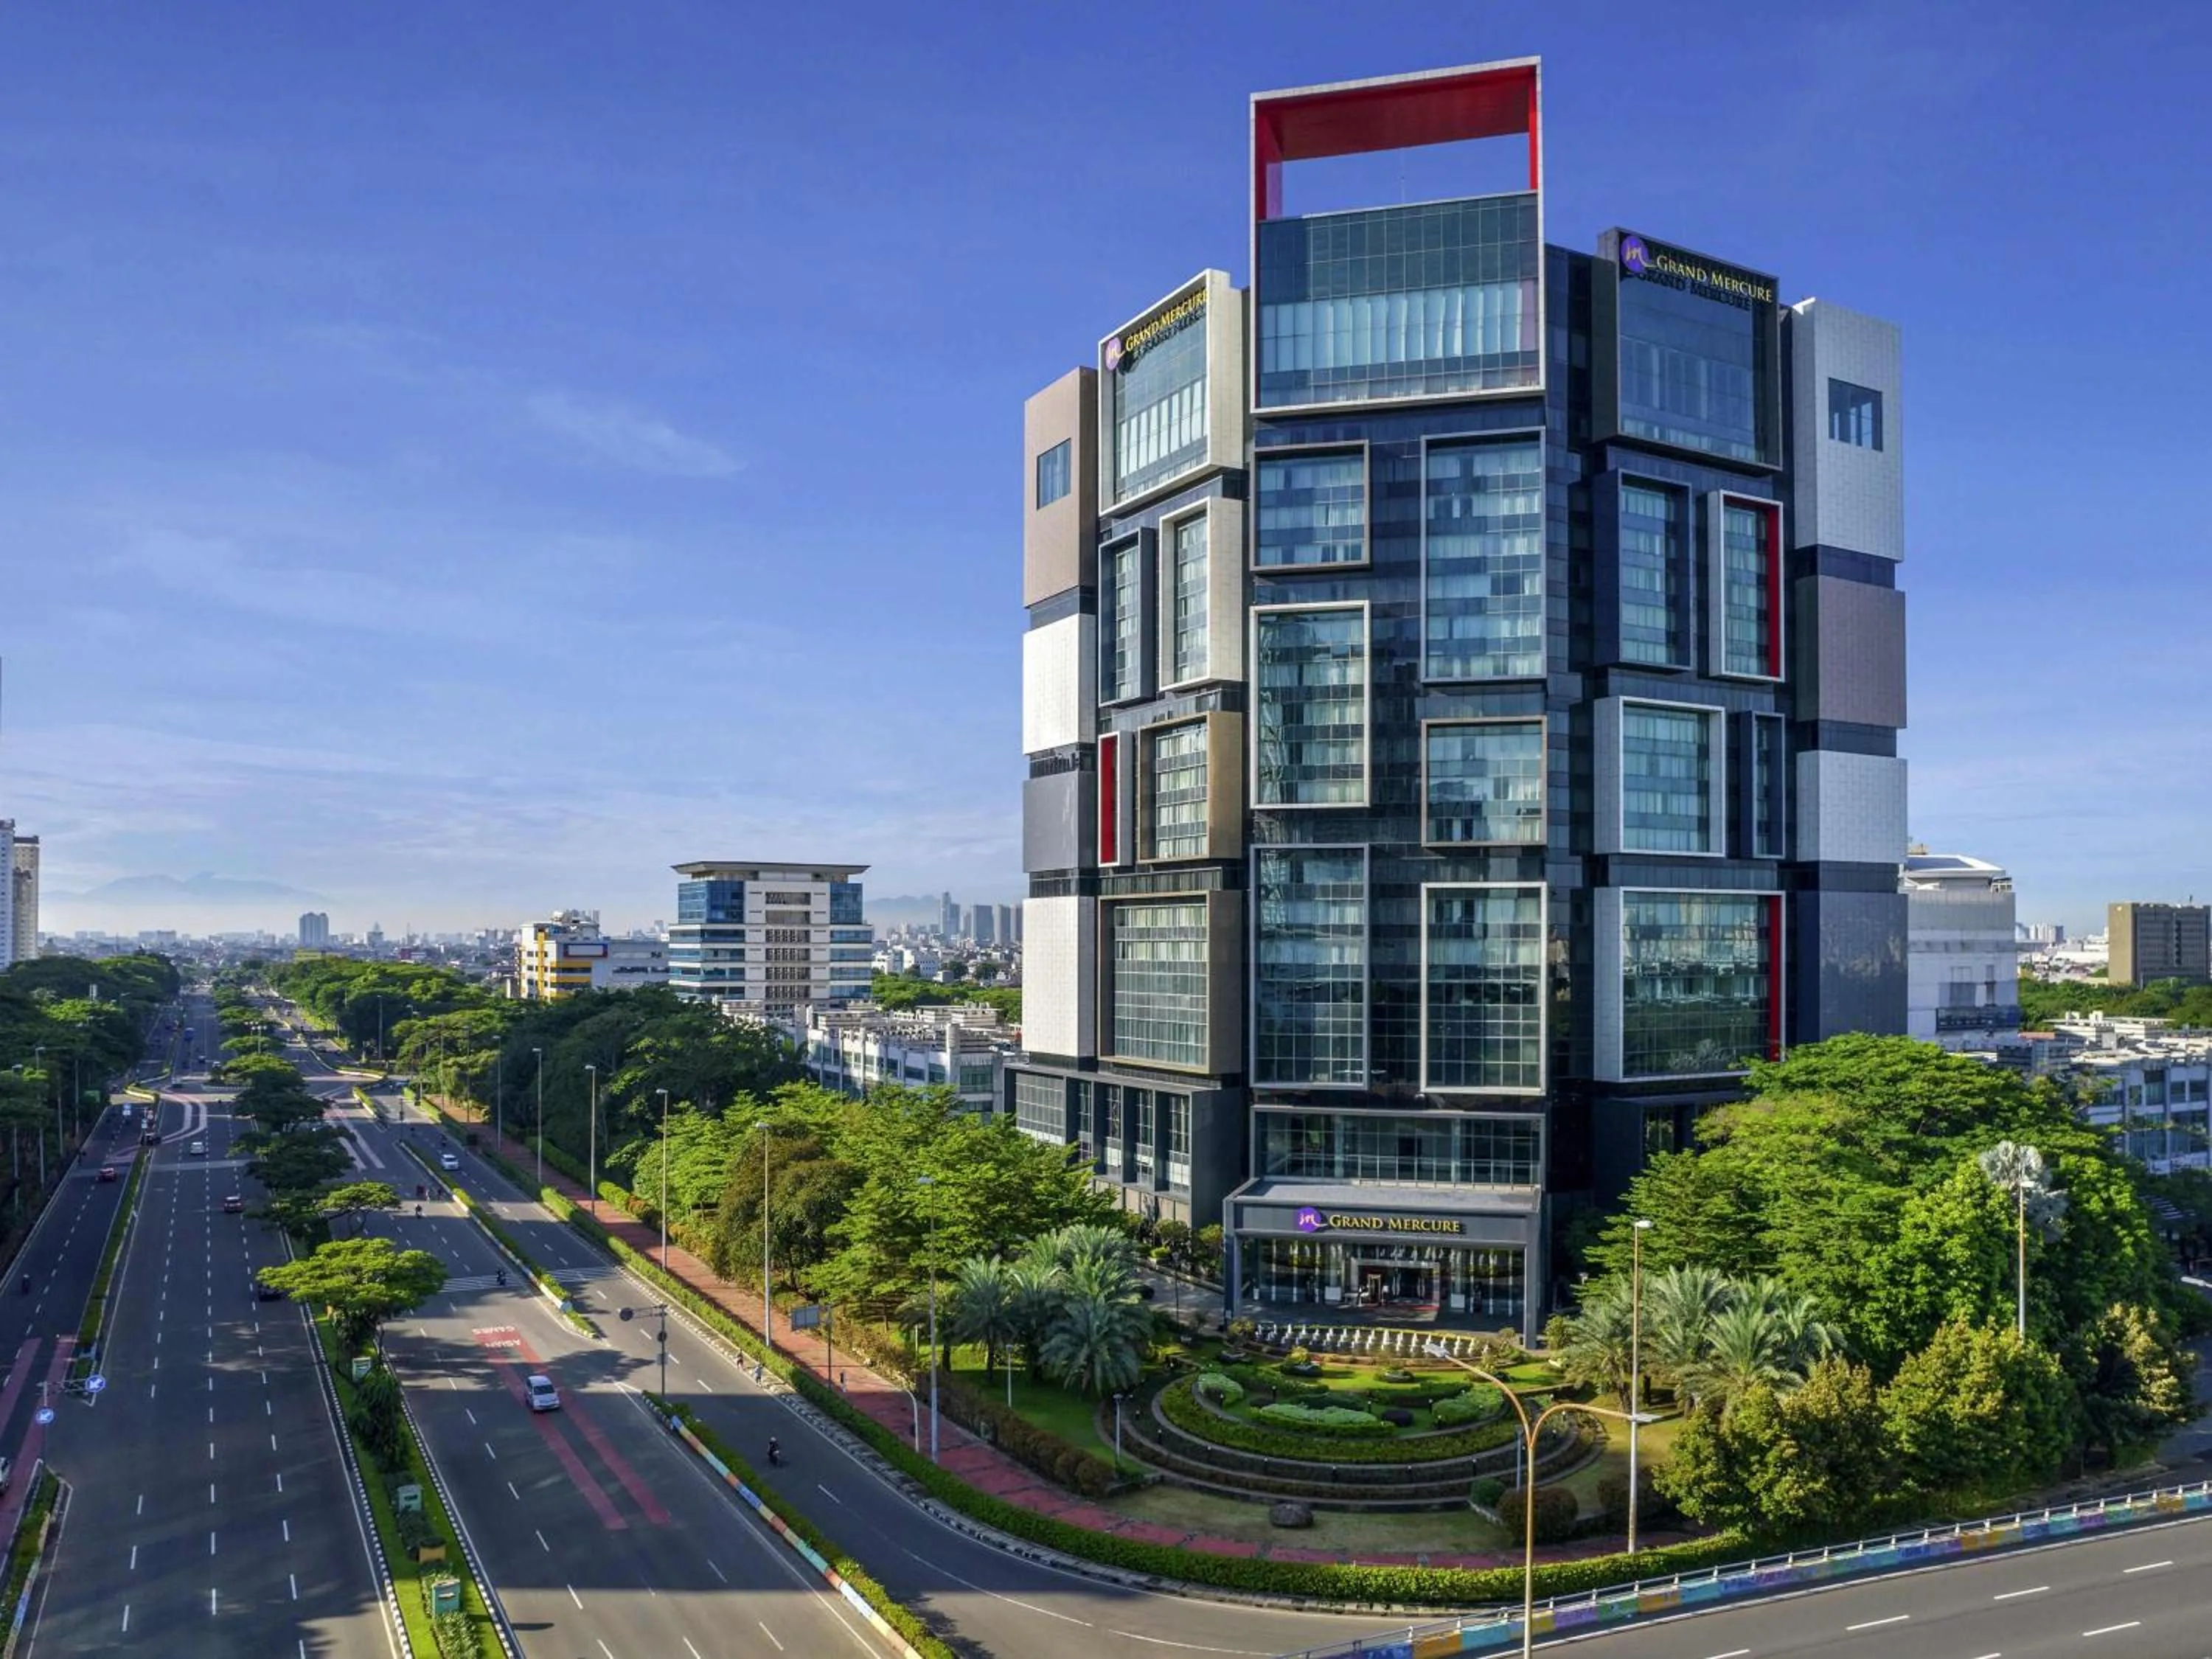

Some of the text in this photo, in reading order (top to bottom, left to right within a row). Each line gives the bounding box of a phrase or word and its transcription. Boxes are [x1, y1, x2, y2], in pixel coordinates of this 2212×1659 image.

[1657, 256, 1706, 282] GRAND
[1711, 272, 1773, 303] MERCURE
[1126, 321, 1158, 352] GRAND
[1329, 1214, 1382, 1229] GRAND
[1388, 1218, 1459, 1232] MERCURE
